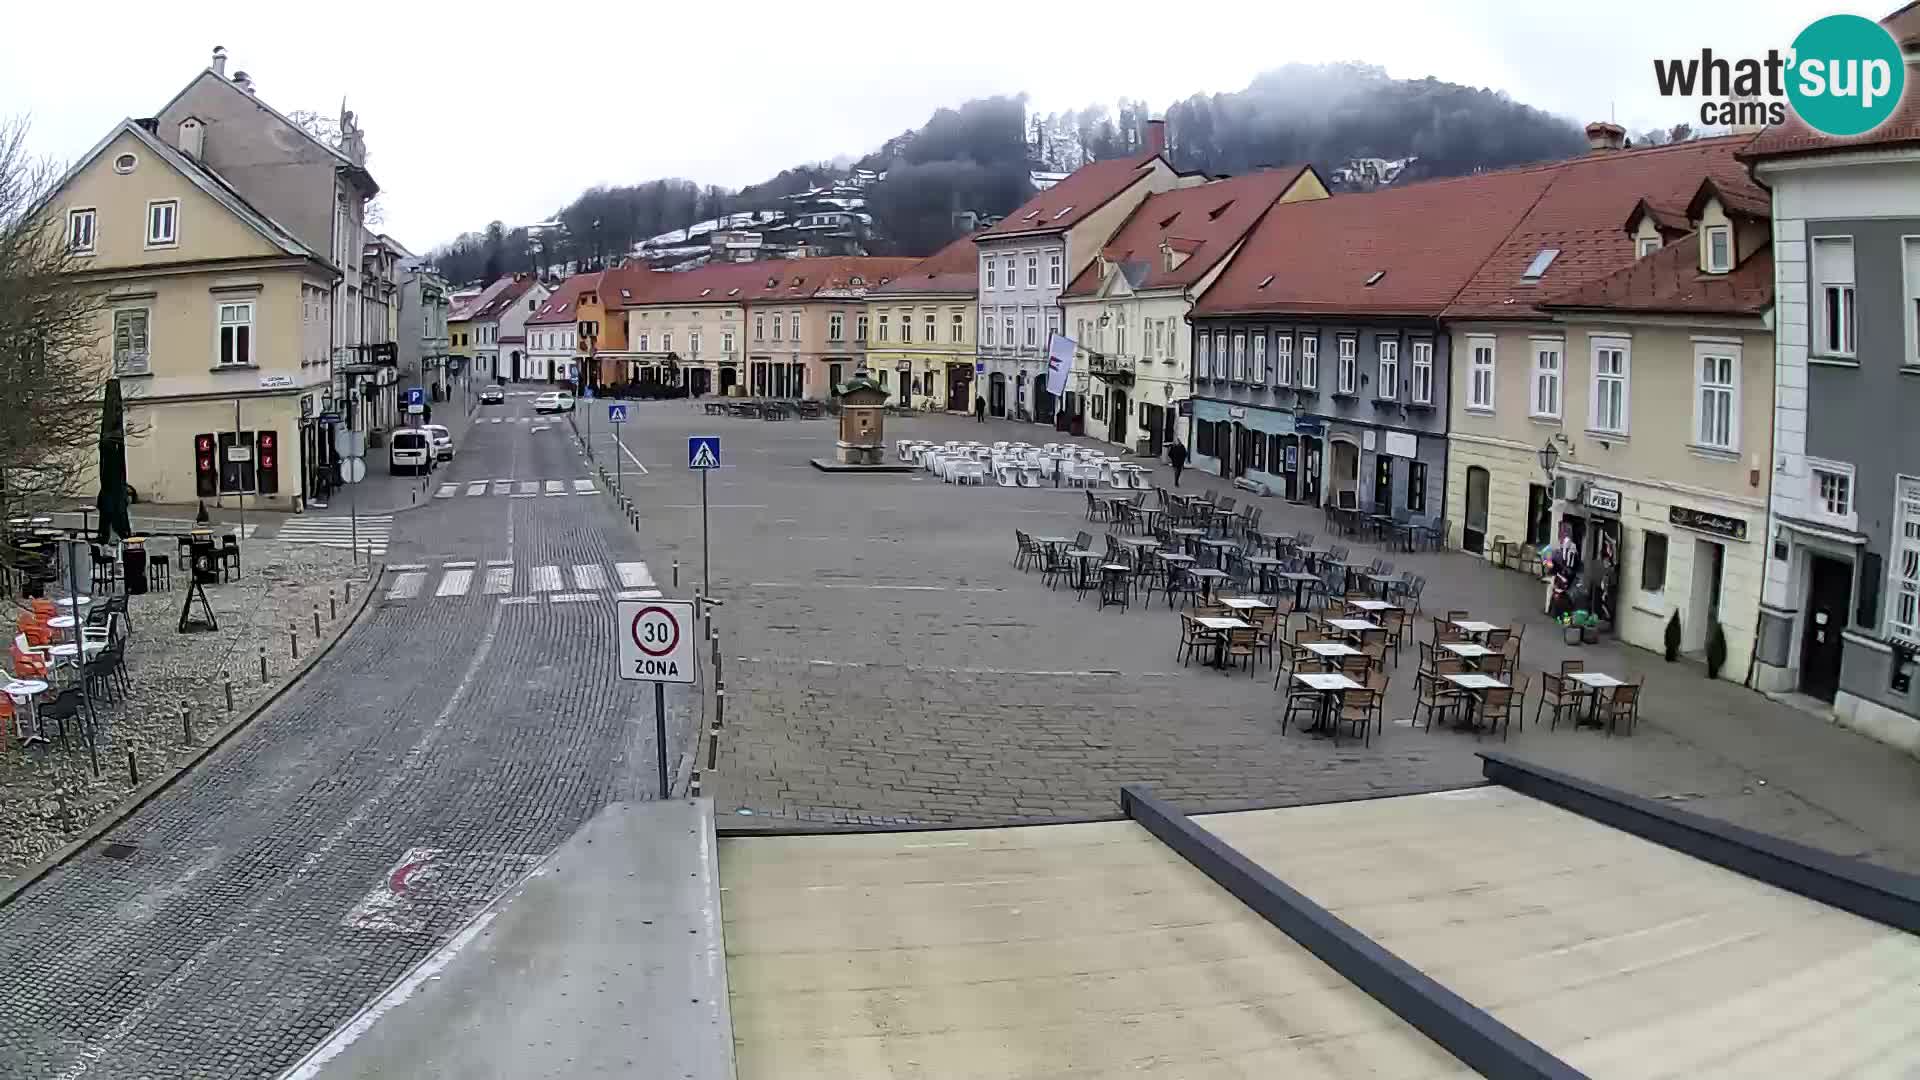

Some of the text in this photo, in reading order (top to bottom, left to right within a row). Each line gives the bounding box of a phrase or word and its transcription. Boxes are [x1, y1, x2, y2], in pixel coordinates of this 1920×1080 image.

[412, 391, 420, 402] P
[644, 622, 668, 643] 30
[634, 659, 679, 676] ZONA
